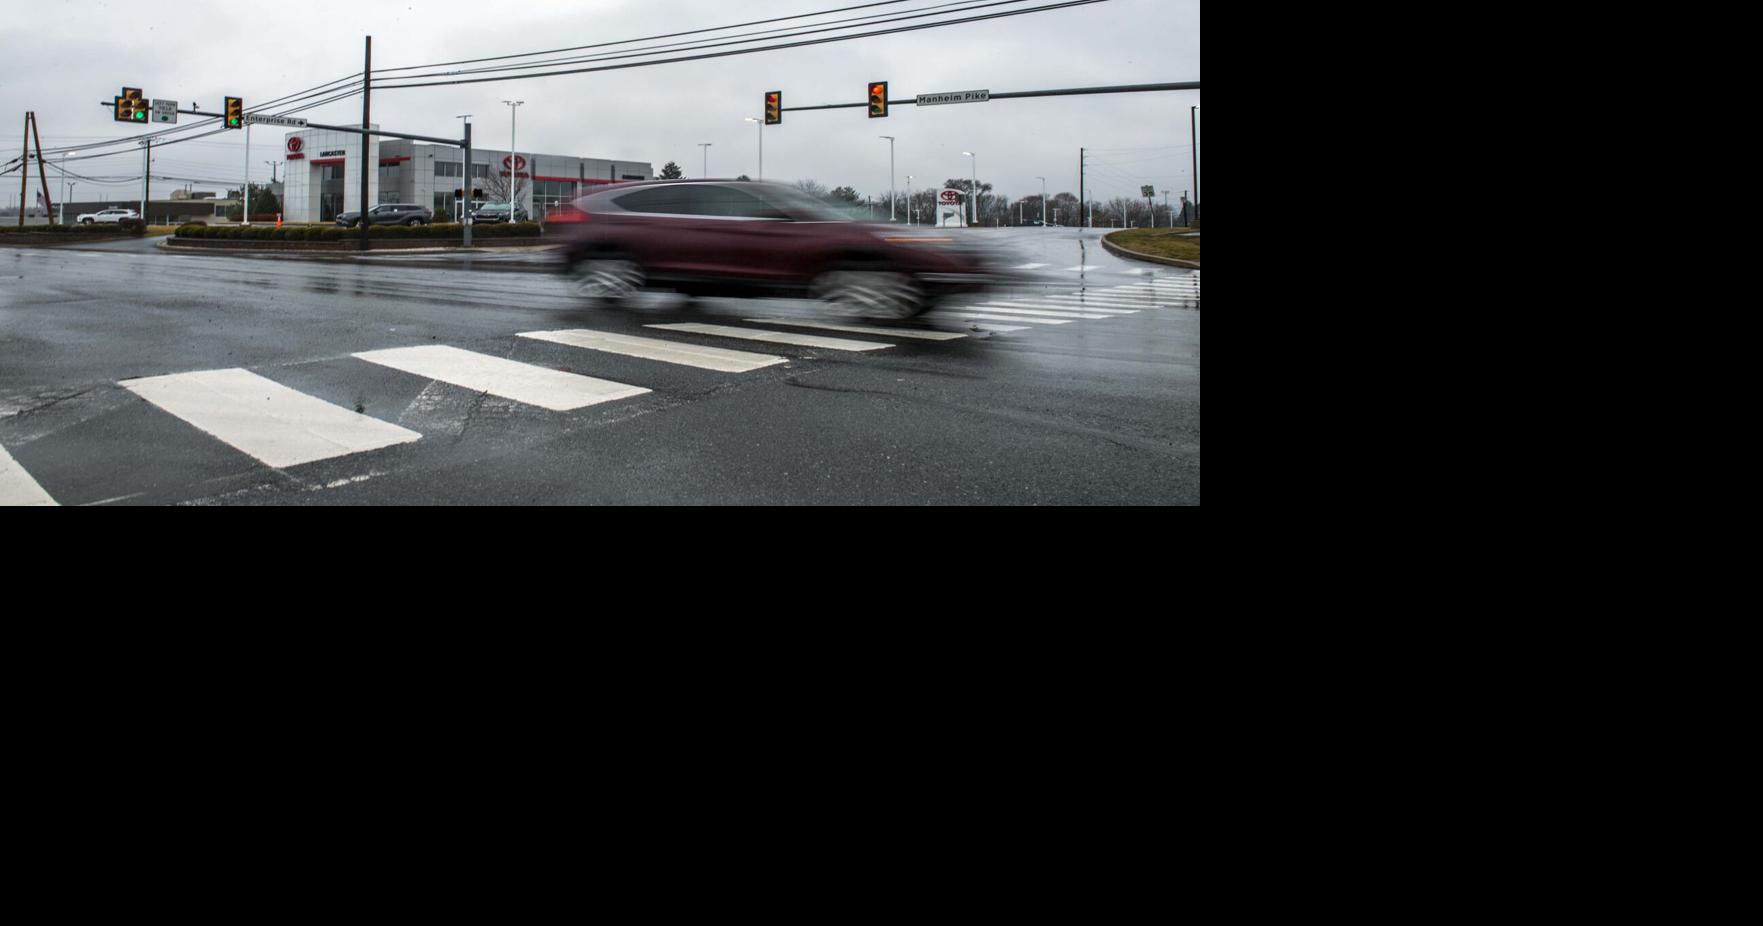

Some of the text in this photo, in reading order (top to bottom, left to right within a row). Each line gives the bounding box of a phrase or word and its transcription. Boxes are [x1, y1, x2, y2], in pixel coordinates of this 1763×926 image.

[919, 92, 986, 103] Manheim Pike
[245, 114, 285, 125] Enterprise
[320, 149, 346, 157] LANCASTER
